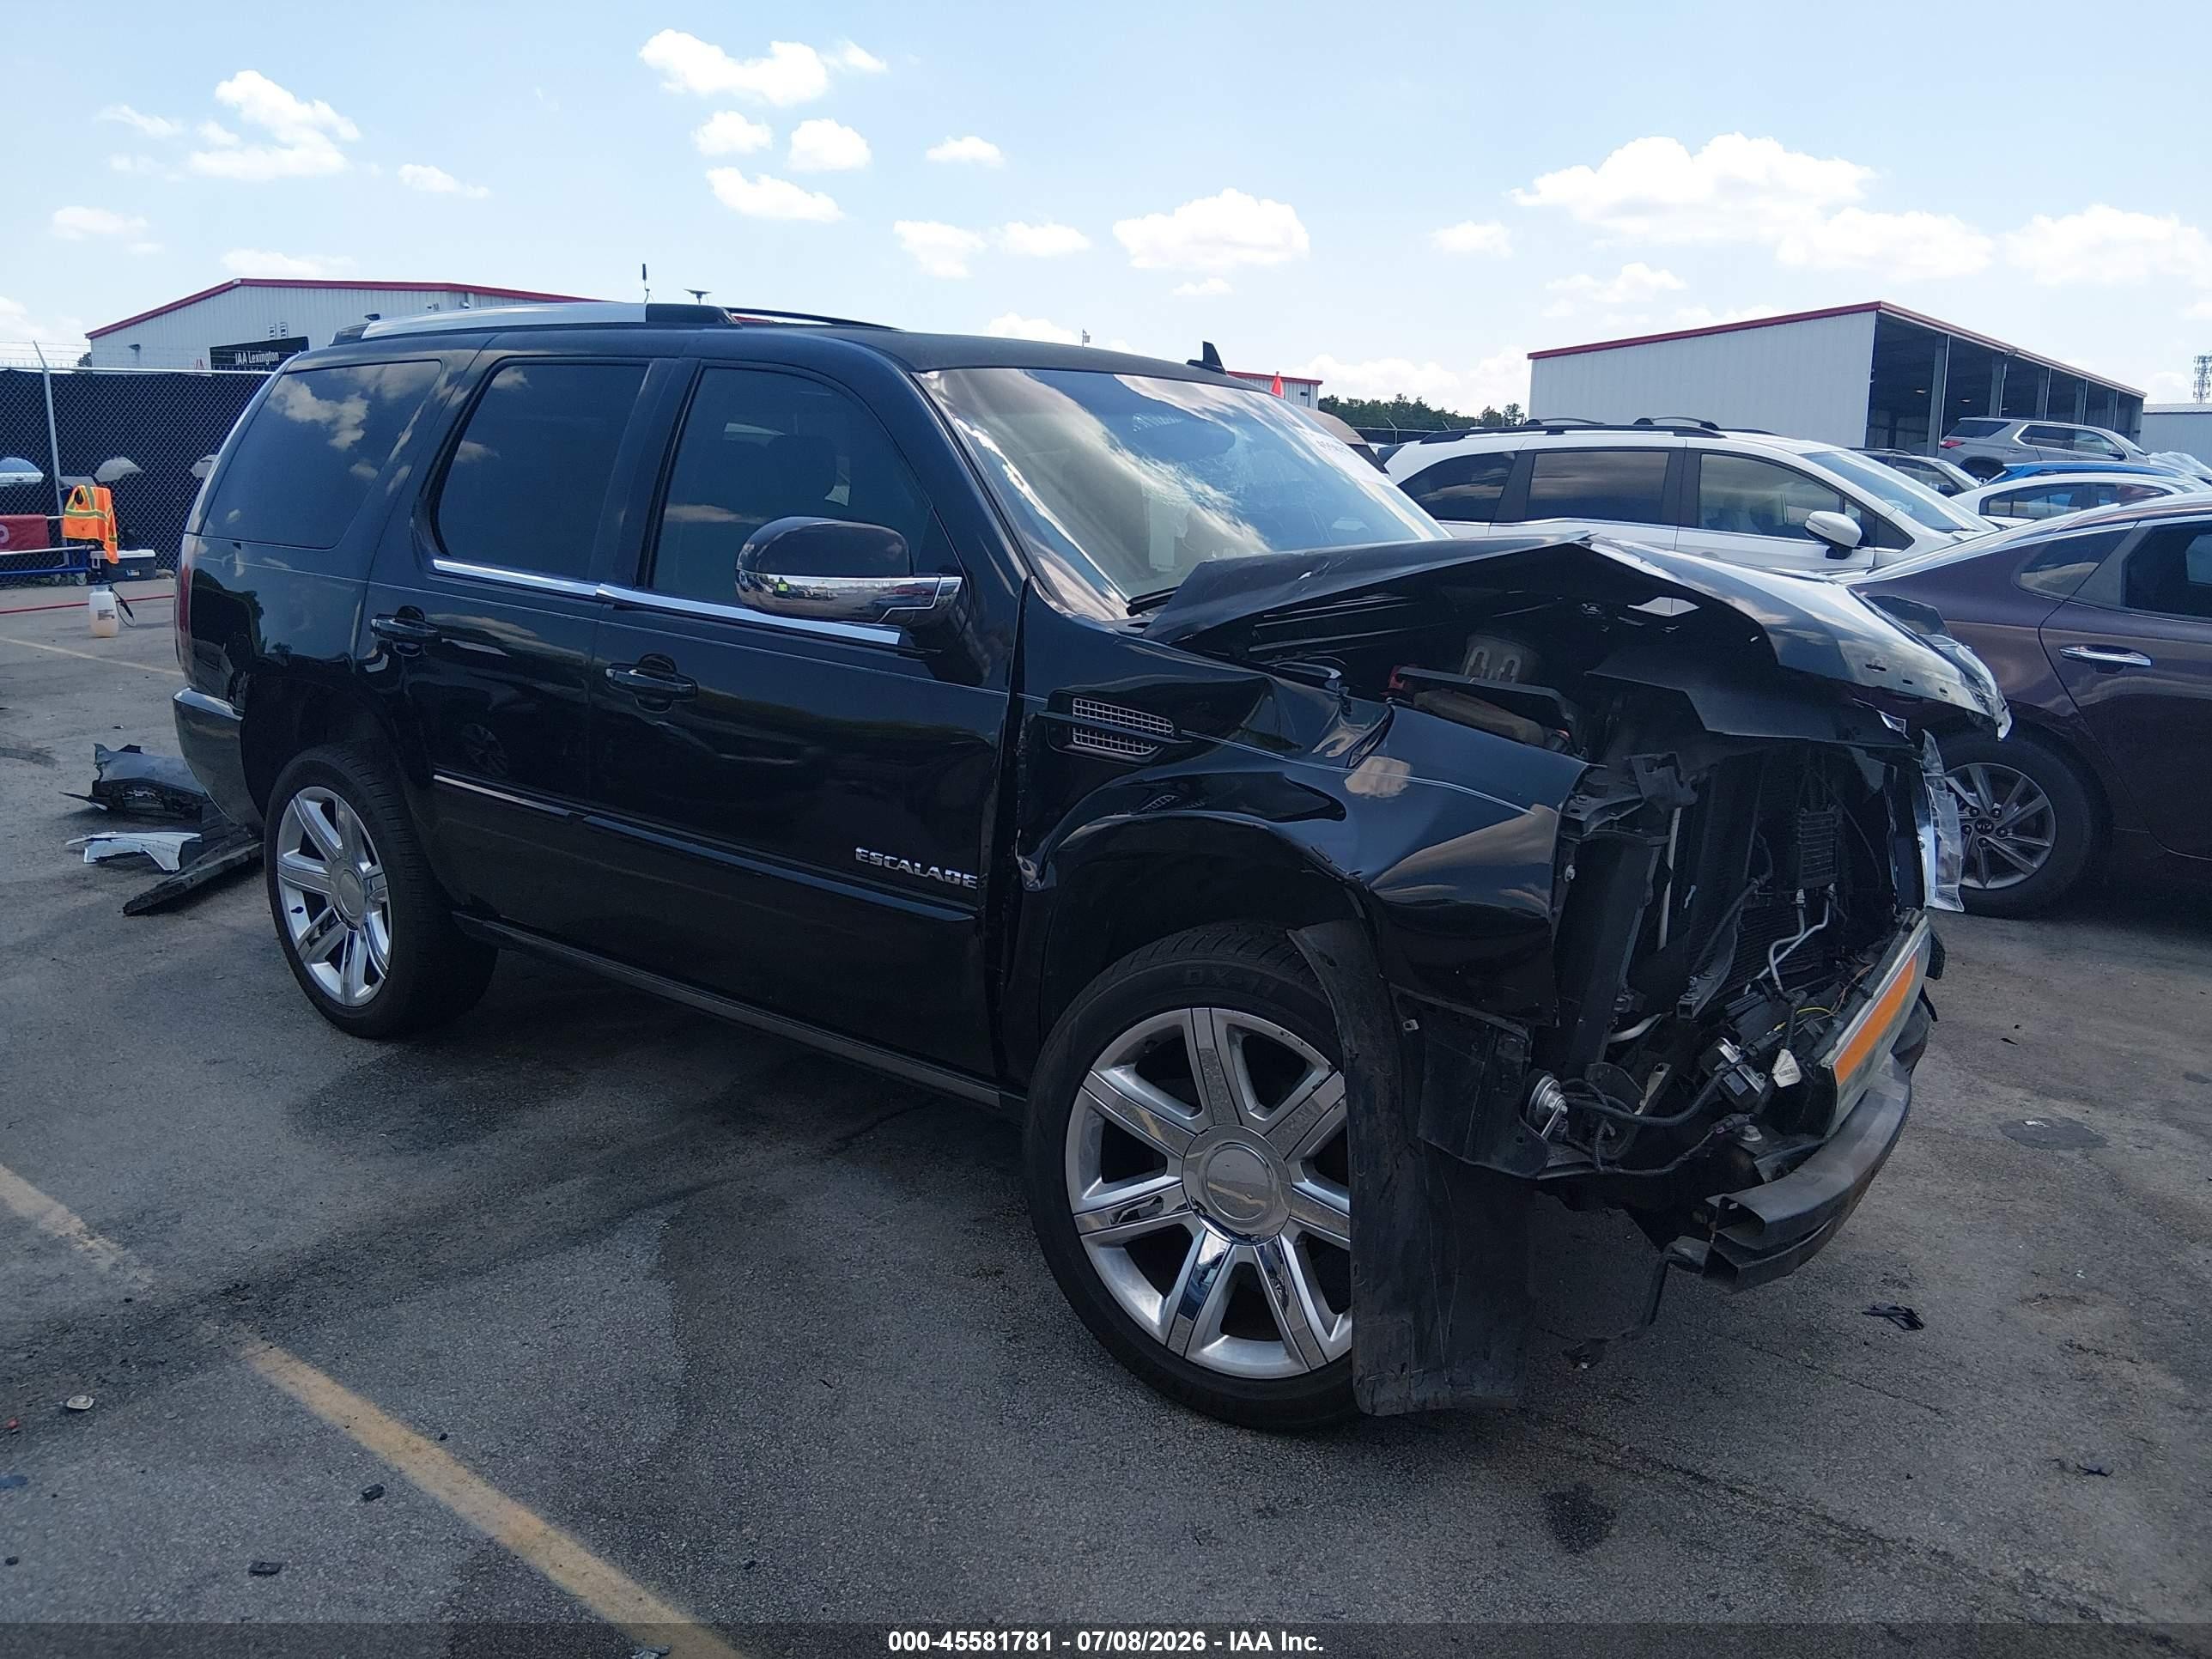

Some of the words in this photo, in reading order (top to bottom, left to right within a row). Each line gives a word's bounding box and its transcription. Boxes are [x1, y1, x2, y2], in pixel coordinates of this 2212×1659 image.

[234, 351, 248, 365] IAA
[247, 350, 280, 365] Lexington
[855, 847, 978, 890] ESCALADE
